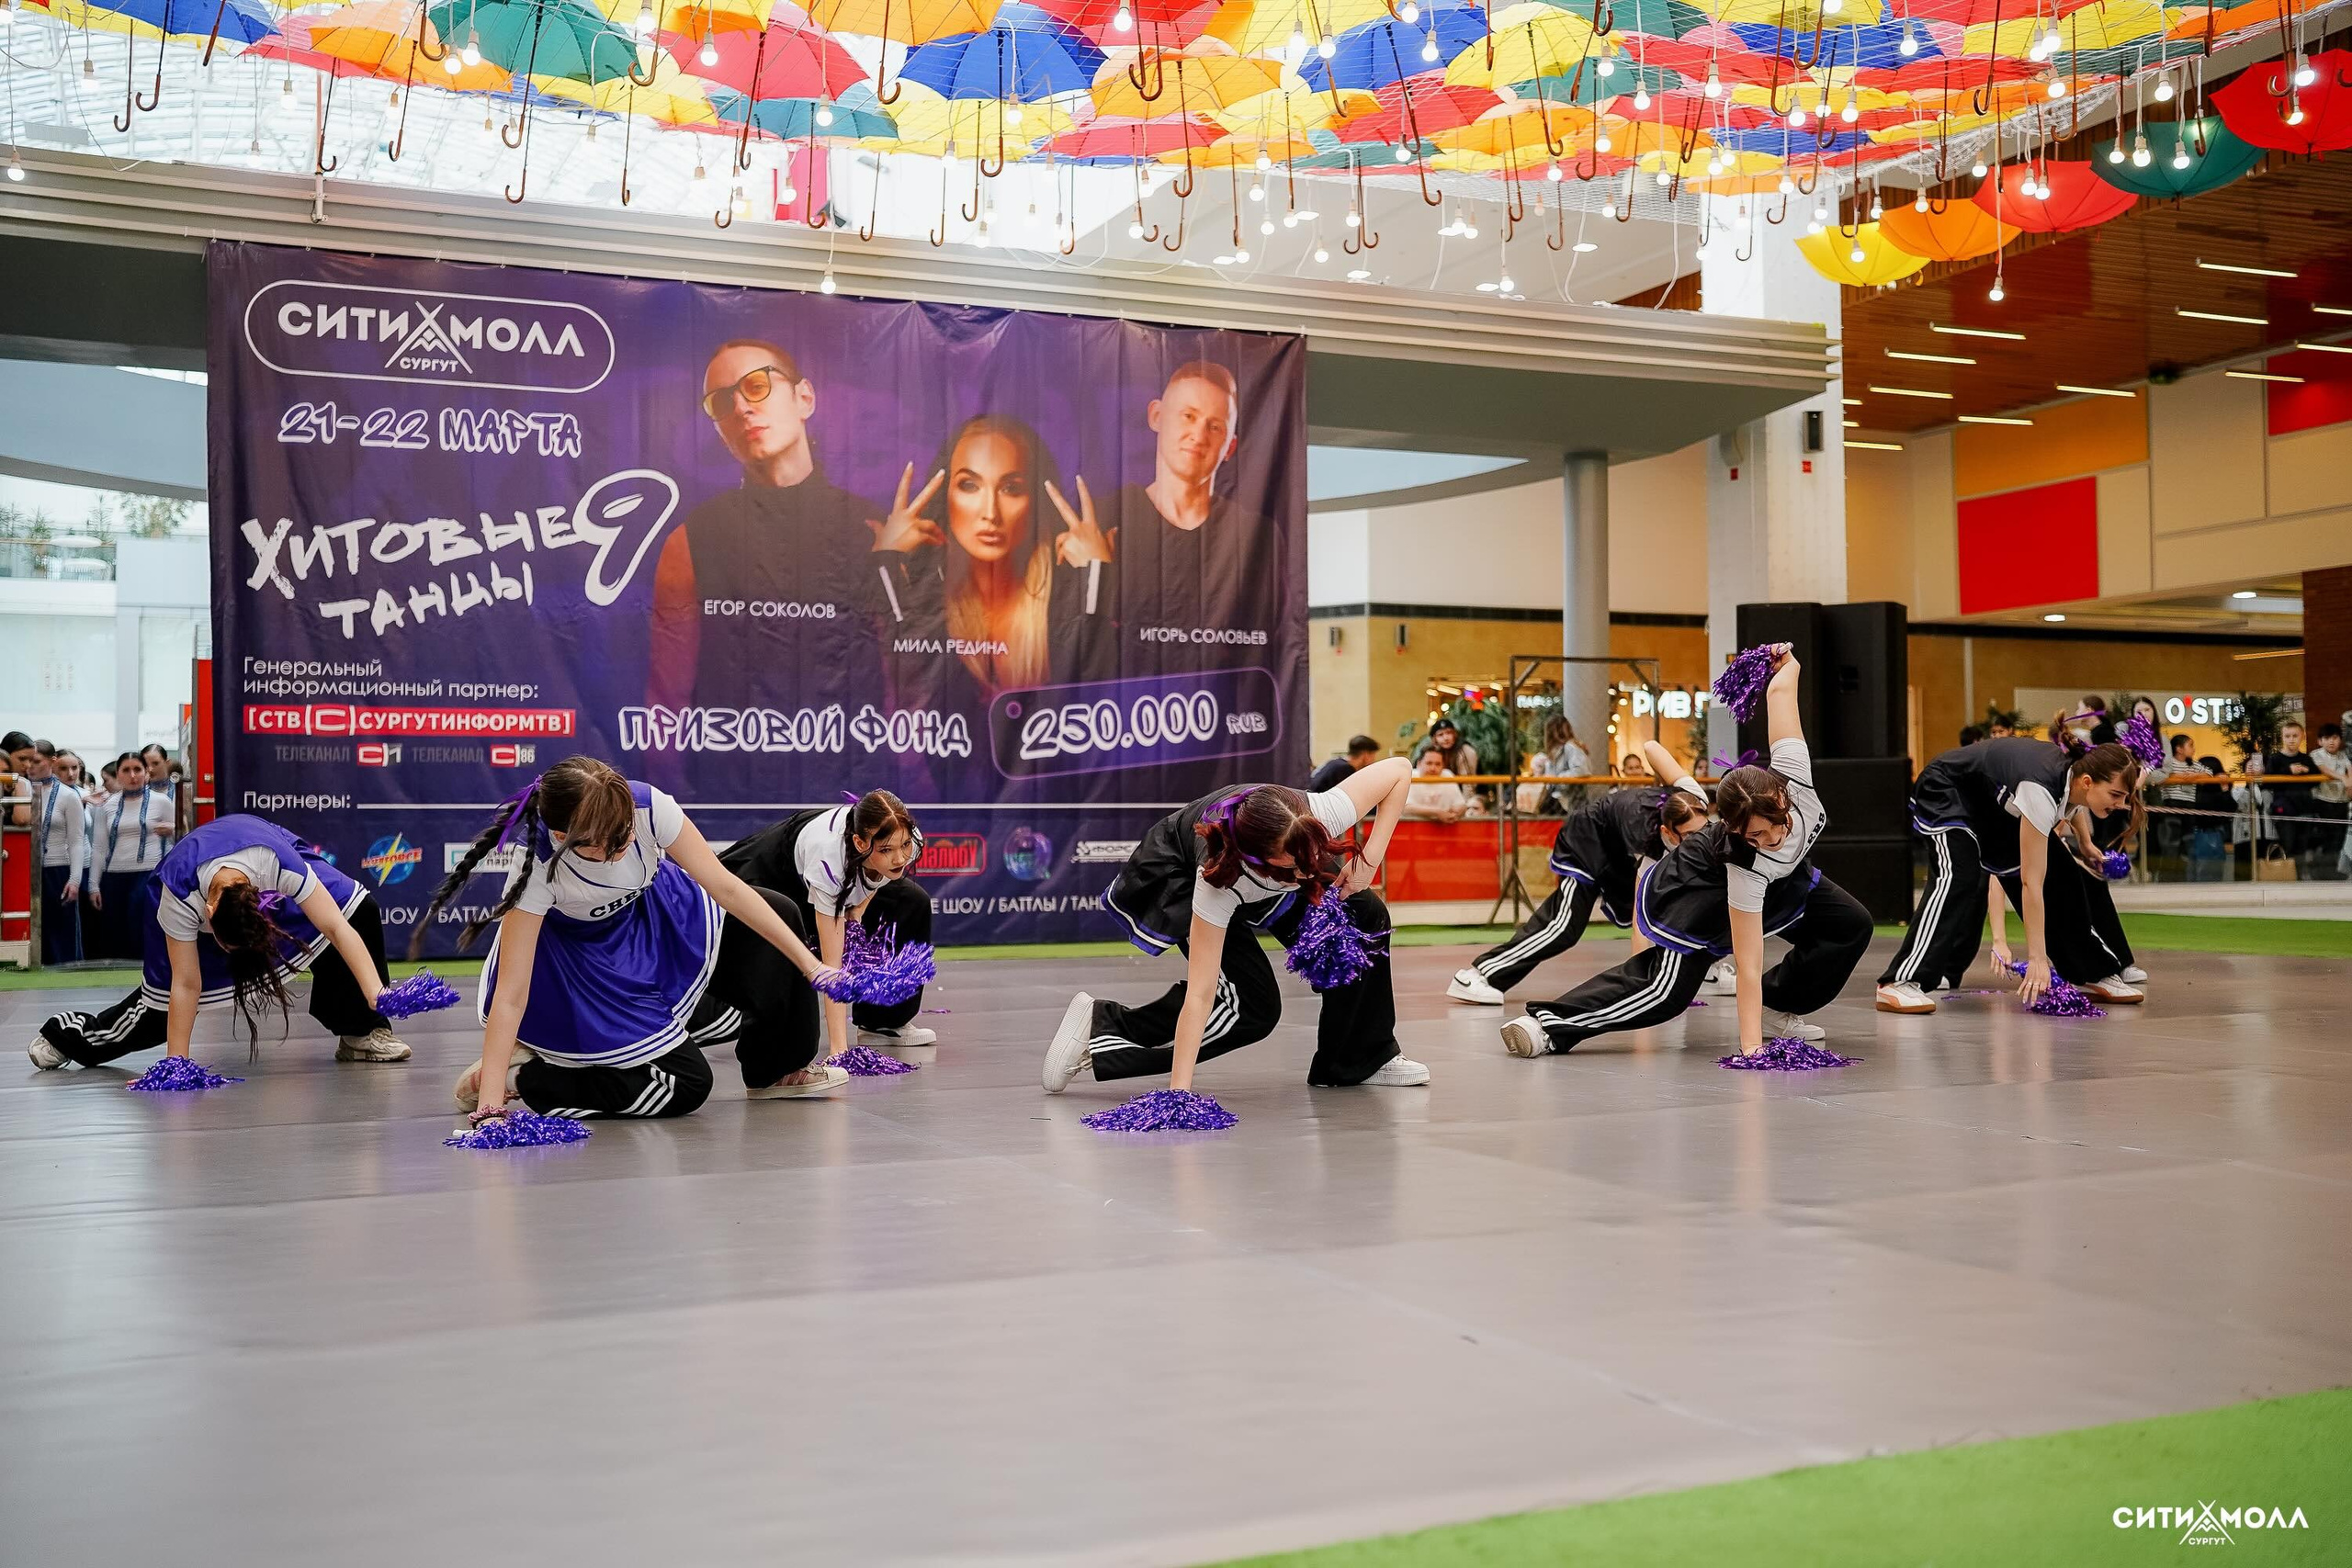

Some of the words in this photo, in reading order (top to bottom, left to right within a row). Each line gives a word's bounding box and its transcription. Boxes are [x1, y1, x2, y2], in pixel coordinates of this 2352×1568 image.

[278, 301, 408, 342] СИТИ
[400, 357, 458, 373] СУРГУТ
[277, 401, 430, 450] 21-22
[439, 409, 582, 458] МАРТА
[241, 505, 579, 600] ХИТОВЫЕ
[319, 561, 534, 639] ТАНЦЫ
[704, 599, 745, 615] ЕГОР
[749, 601, 836, 619] СОКОЛОВ
[893, 638, 943, 654] МИЛА
[946, 639, 1009, 655] РЕДИНА
[1140, 626, 1188, 642] ИГОРЬ
[1191, 628, 1268, 645] СОЛОВЬЕВ
[243, 657, 382, 679] Генеральный
[243, 677, 443, 697] информационный
[448, 683, 539, 703] партнер:
[618, 704, 845, 754] ПРИЗОВОЙ
[850, 704, 972, 758] ФОНД
[1020, 690, 1218, 761] 250.000
[1226, 711, 1268, 734] RUB
[276, 744, 350, 761] ТЕЛЕКАНАЛ
[413, 746, 483, 763] ТЕЛЕКАНАЛ
[243, 791, 351, 813] Партнеры:
[943, 897, 984, 914] ШОУ
[999, 896, 1057, 913] БАТТЛЫ
